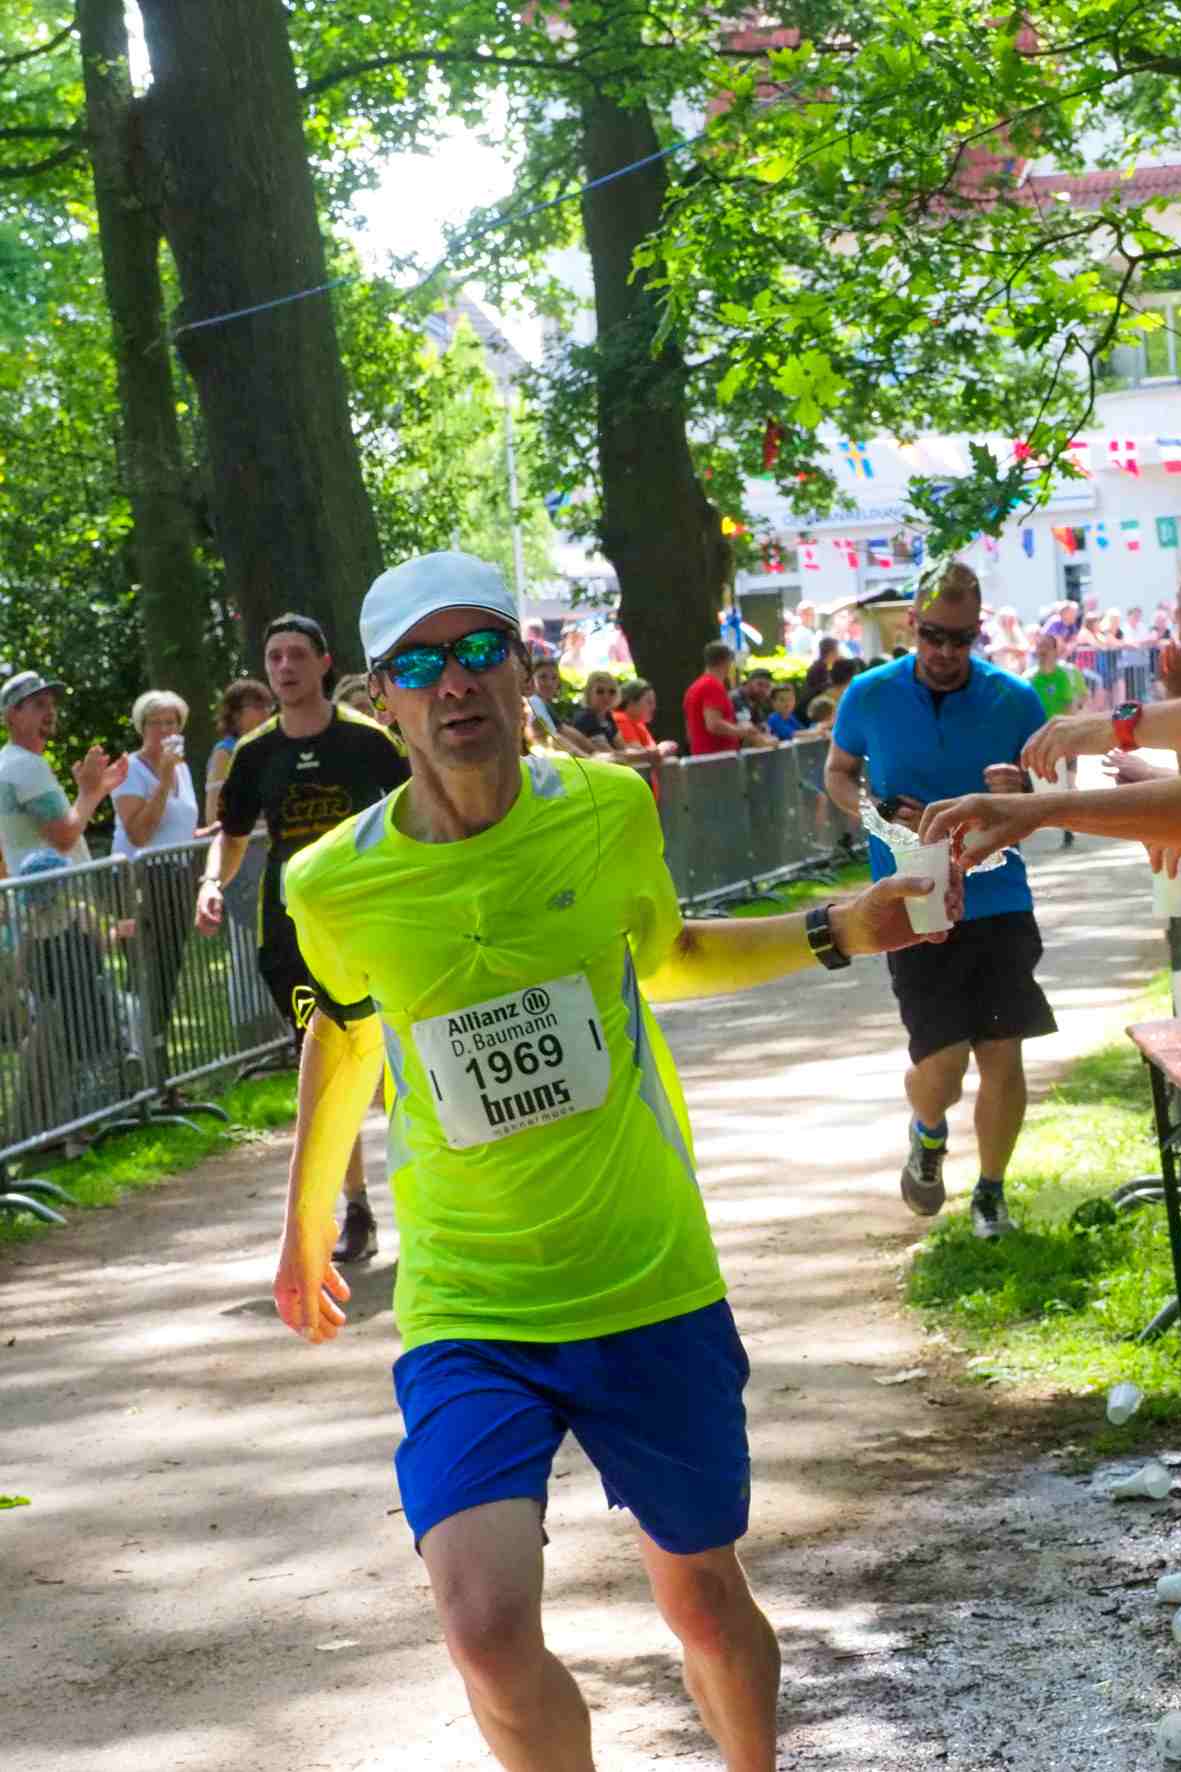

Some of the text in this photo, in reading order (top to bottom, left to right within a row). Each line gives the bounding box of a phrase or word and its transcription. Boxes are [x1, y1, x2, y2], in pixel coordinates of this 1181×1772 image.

[448, 1001, 520, 1037] Allianz
[451, 1012, 558, 1058] D. Baumann
[465, 1033, 563, 1090] 1969
[480, 1079, 571, 1127] bruns
